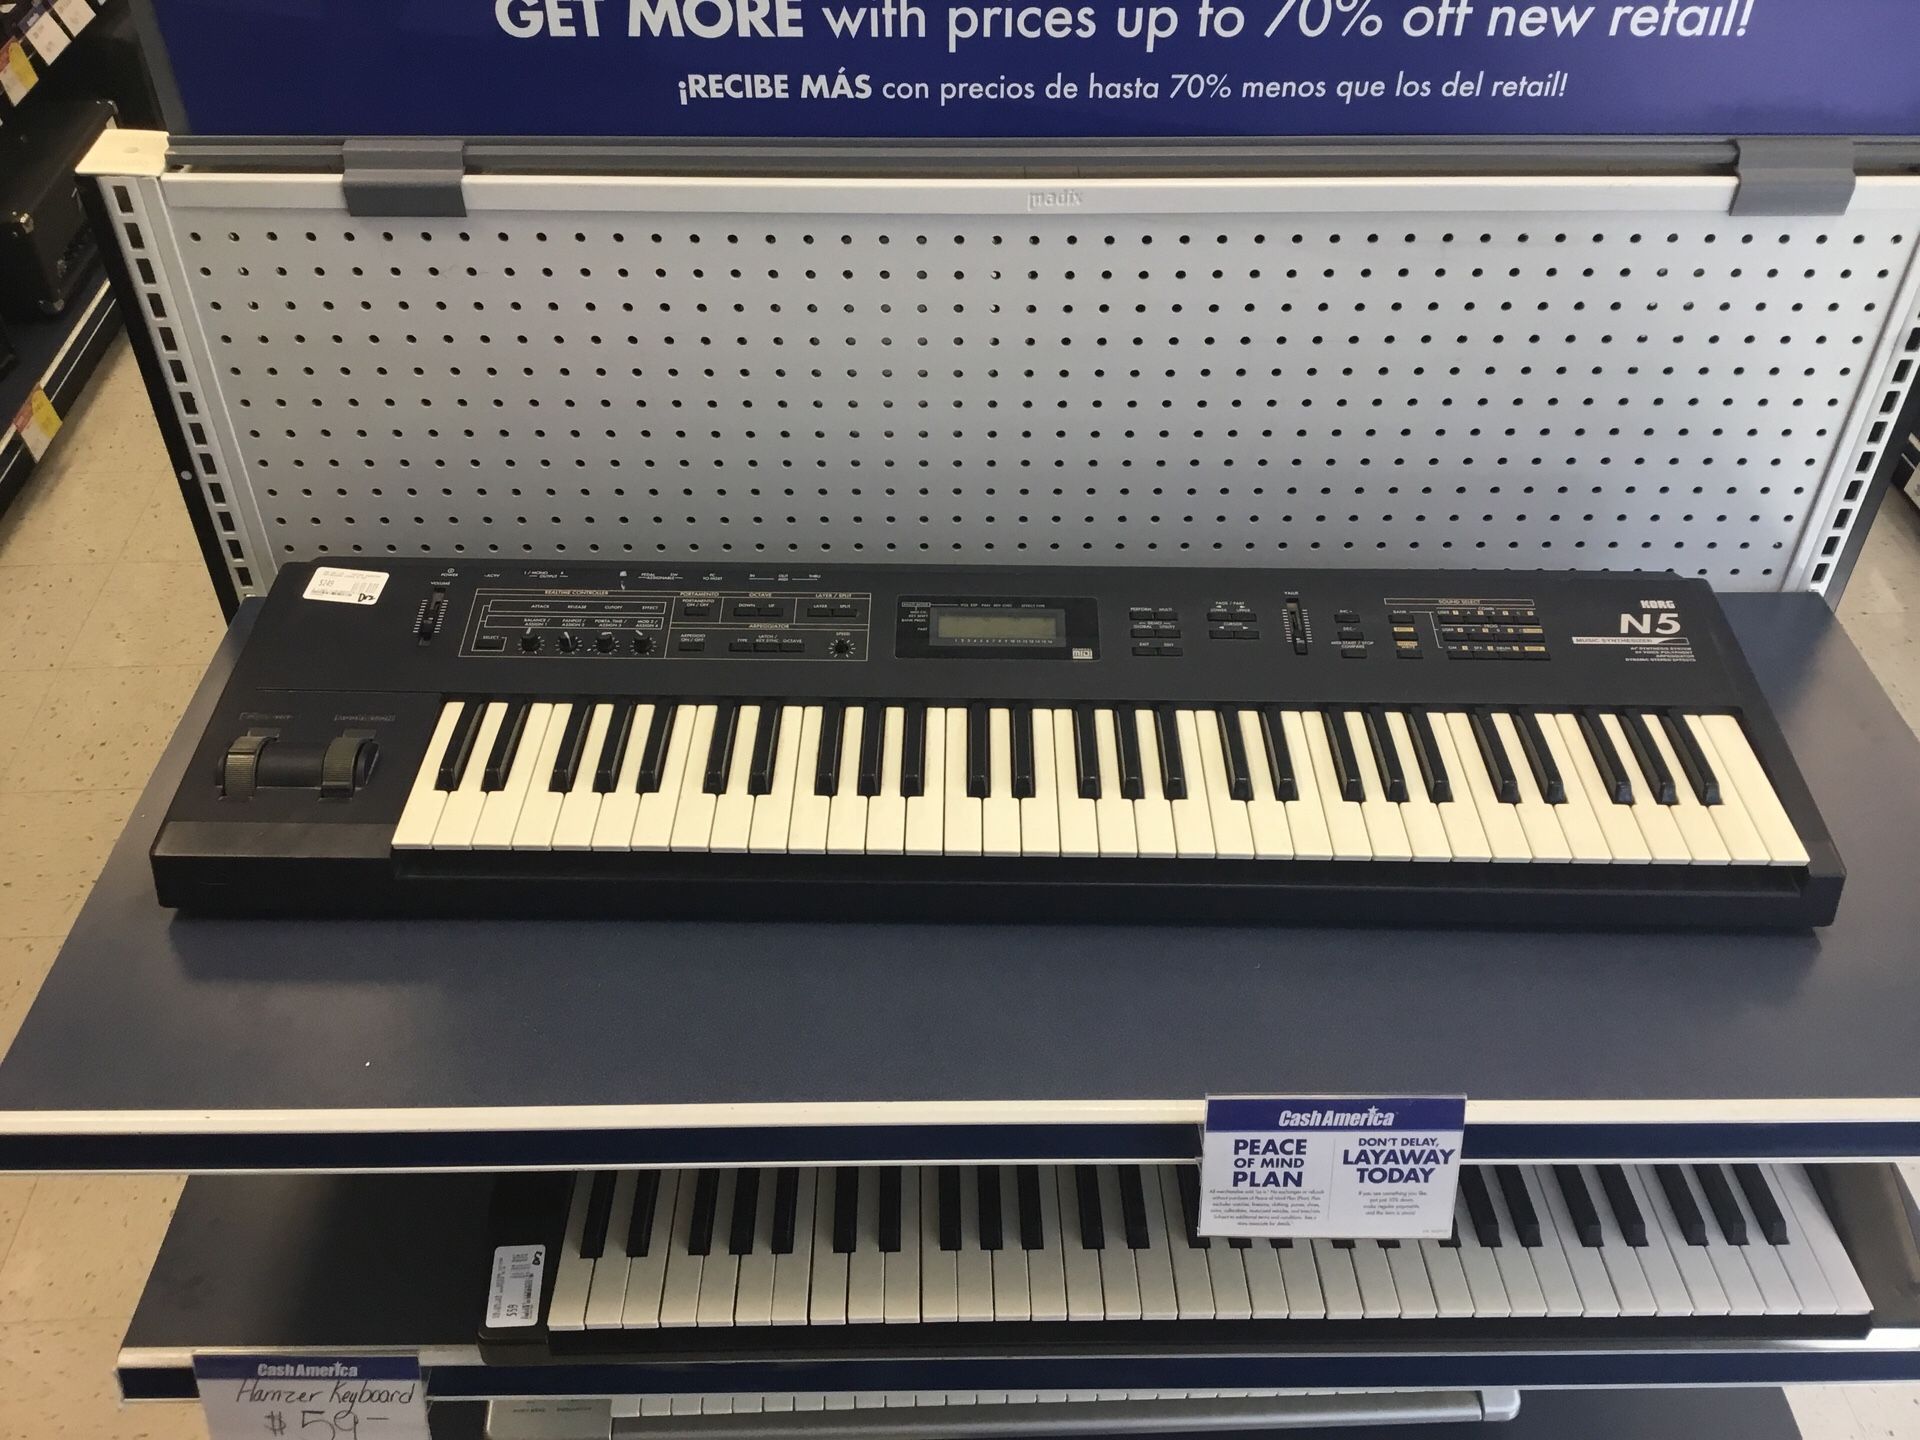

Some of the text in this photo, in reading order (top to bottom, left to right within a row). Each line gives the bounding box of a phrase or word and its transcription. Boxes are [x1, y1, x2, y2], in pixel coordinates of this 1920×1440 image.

[495, 0, 1755, 52] GET MORE with prices up to 70% off new retail!
[678, 66, 1569, 106] ¡RECIBE MÁS con precios de hasta 70% menos que los del retail!
[1639, 600, 1676, 609] KORG
[1620, 613, 1681, 635] N5
[1233, 1138, 1308, 1155] PEACE
[1358, 1137, 1440, 1149] DON'T DELAY,
[1233, 1157, 1305, 1168] OF MIND
[1342, 1149, 1456, 1165] LAYAWAY
[1232, 1170, 1304, 1187] PLAN
[1356, 1167, 1436, 1183] TODAY
[328, 1379, 417, 1414] Keyboard
